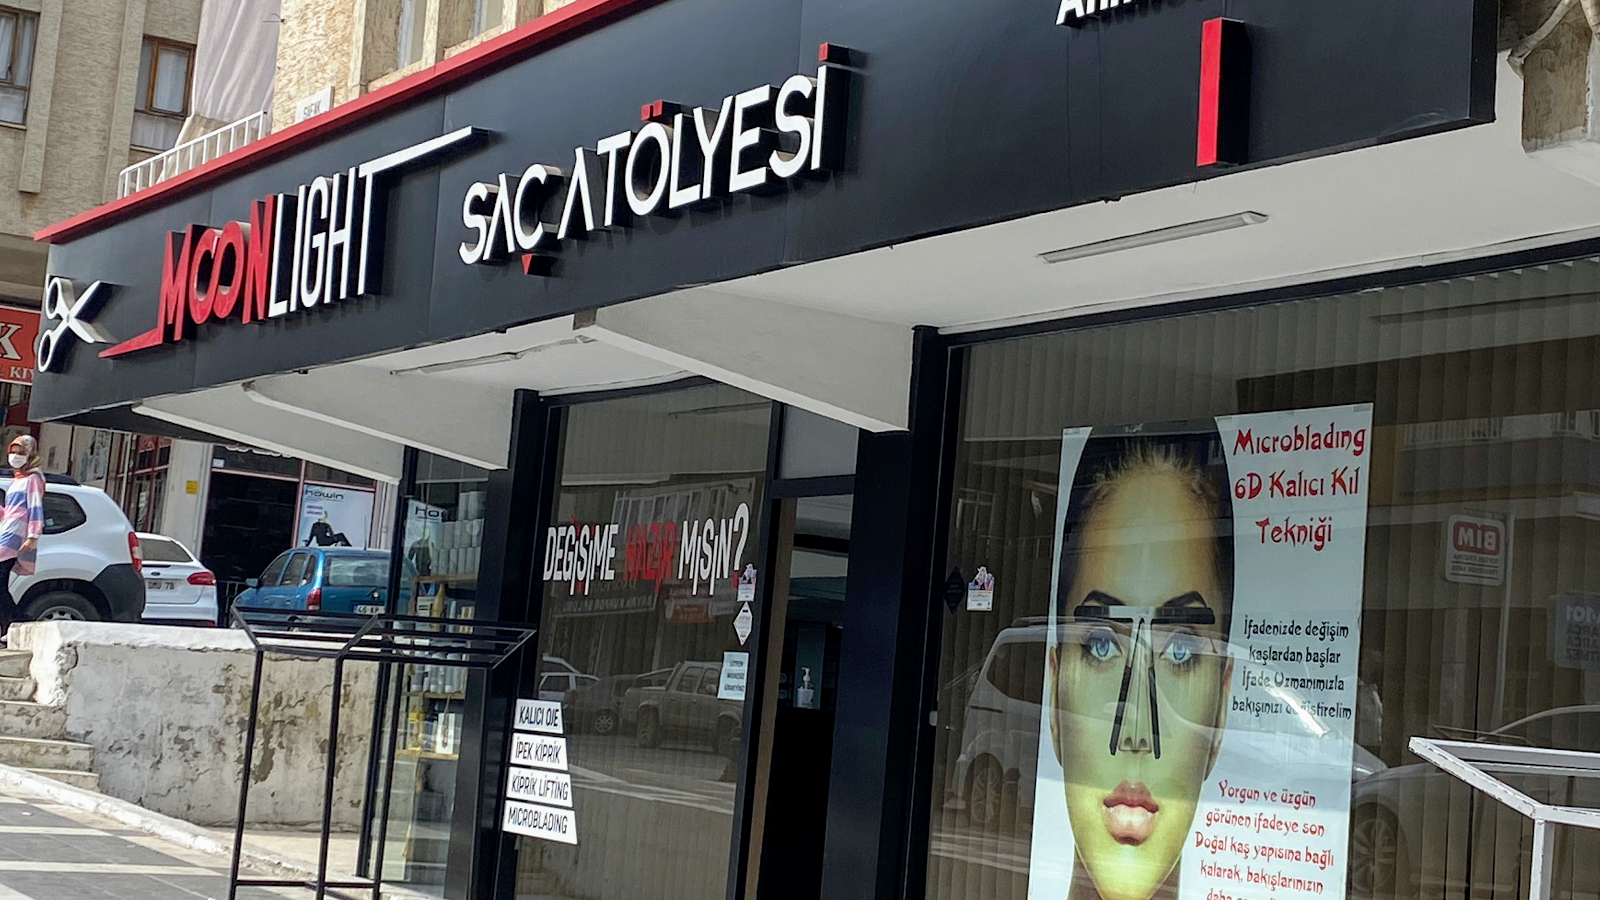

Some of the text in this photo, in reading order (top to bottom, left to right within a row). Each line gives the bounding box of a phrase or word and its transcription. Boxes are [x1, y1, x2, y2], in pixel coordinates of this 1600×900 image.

[99, 42, 829, 357] MOONLIGHT SAÇ ATÖLYESİ
[1235, 466, 1360, 499] 6D Kalıcı Kıl
[1255, 516, 1332, 551] Tekniği
[1244, 615, 1349, 641] İfadenizde değişim
[1249, 645, 1341, 668] kaşlardan başlar
[1242, 666, 1270, 690] İfade
[519, 706, 545, 725] KALICI
[1232, 696, 1282, 717] bakışınızı
[515, 736, 562, 763] İPEK KİPRİK
[511, 771, 569, 801] KİPRİK LİFTİNG
[1218, 779, 1316, 810] Yorgun ve üzgün
[508, 806, 568, 834] MICROBLADING
[1206, 808, 1325, 837] görünen ifadeye son
[1195, 831, 1334, 870] Doğal kaş yapısına bağlı
[1246, 866, 1324, 895] bakışlarınızın
